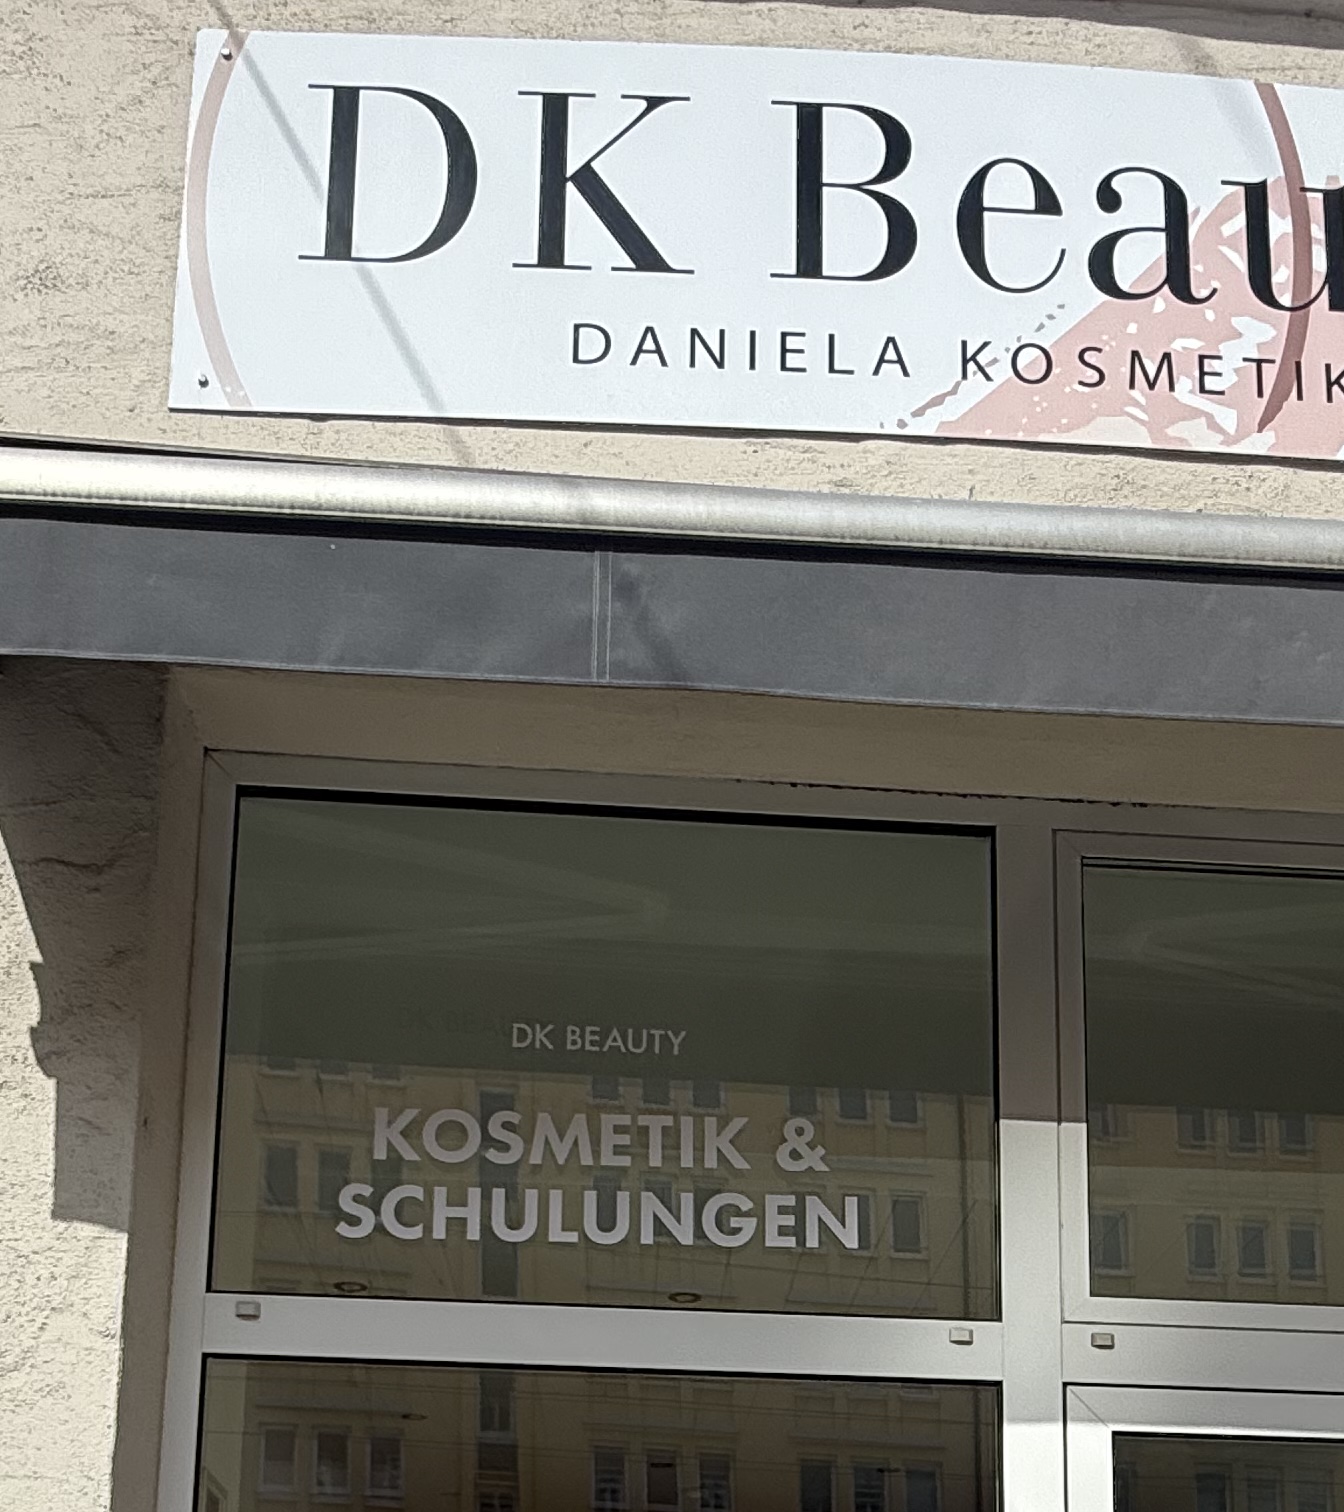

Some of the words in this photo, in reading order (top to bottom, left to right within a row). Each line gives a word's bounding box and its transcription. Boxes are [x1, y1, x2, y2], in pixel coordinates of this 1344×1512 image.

[299, 83, 694, 277] DK
[570, 321, 913, 380] DANIELA
[511, 1022, 555, 1051] DK
[566, 1024, 687, 1056] BEAUTY
[372, 1106, 751, 1171] KOSMETIK
[775, 1116, 830, 1173] &
[334, 1182, 859, 1250] SCHULUNGEN
